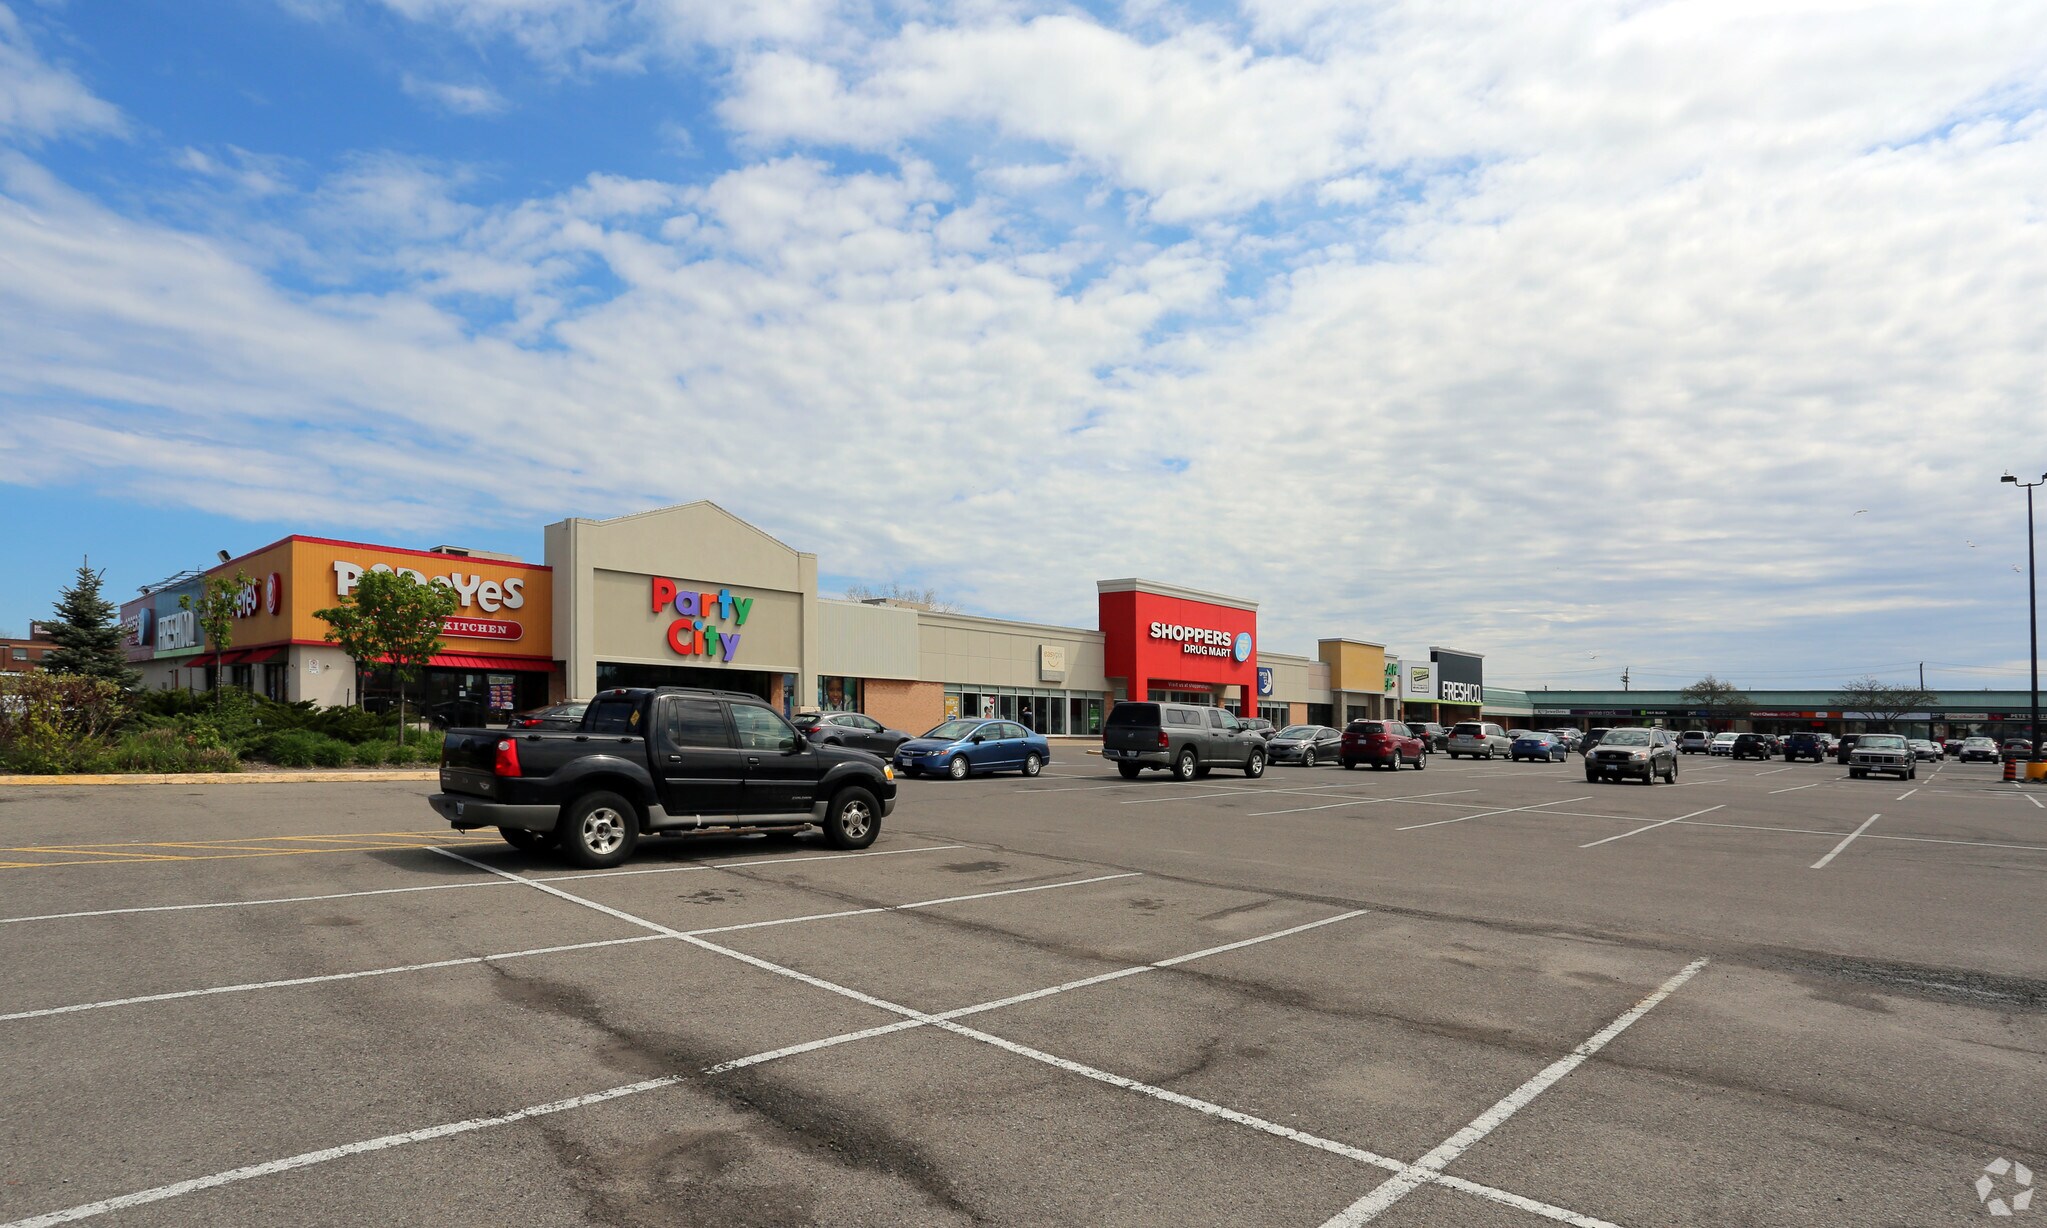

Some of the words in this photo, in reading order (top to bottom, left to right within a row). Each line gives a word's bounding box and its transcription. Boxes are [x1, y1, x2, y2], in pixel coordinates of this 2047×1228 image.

[651, 576, 754, 626] Party
[443, 621, 507, 634] KITCHEN
[1150, 621, 1232, 647] SHOPPERS
[667, 620, 741, 663] City
[1184, 643, 1207, 655] DRUG
[1208, 646, 1231, 657] MART
